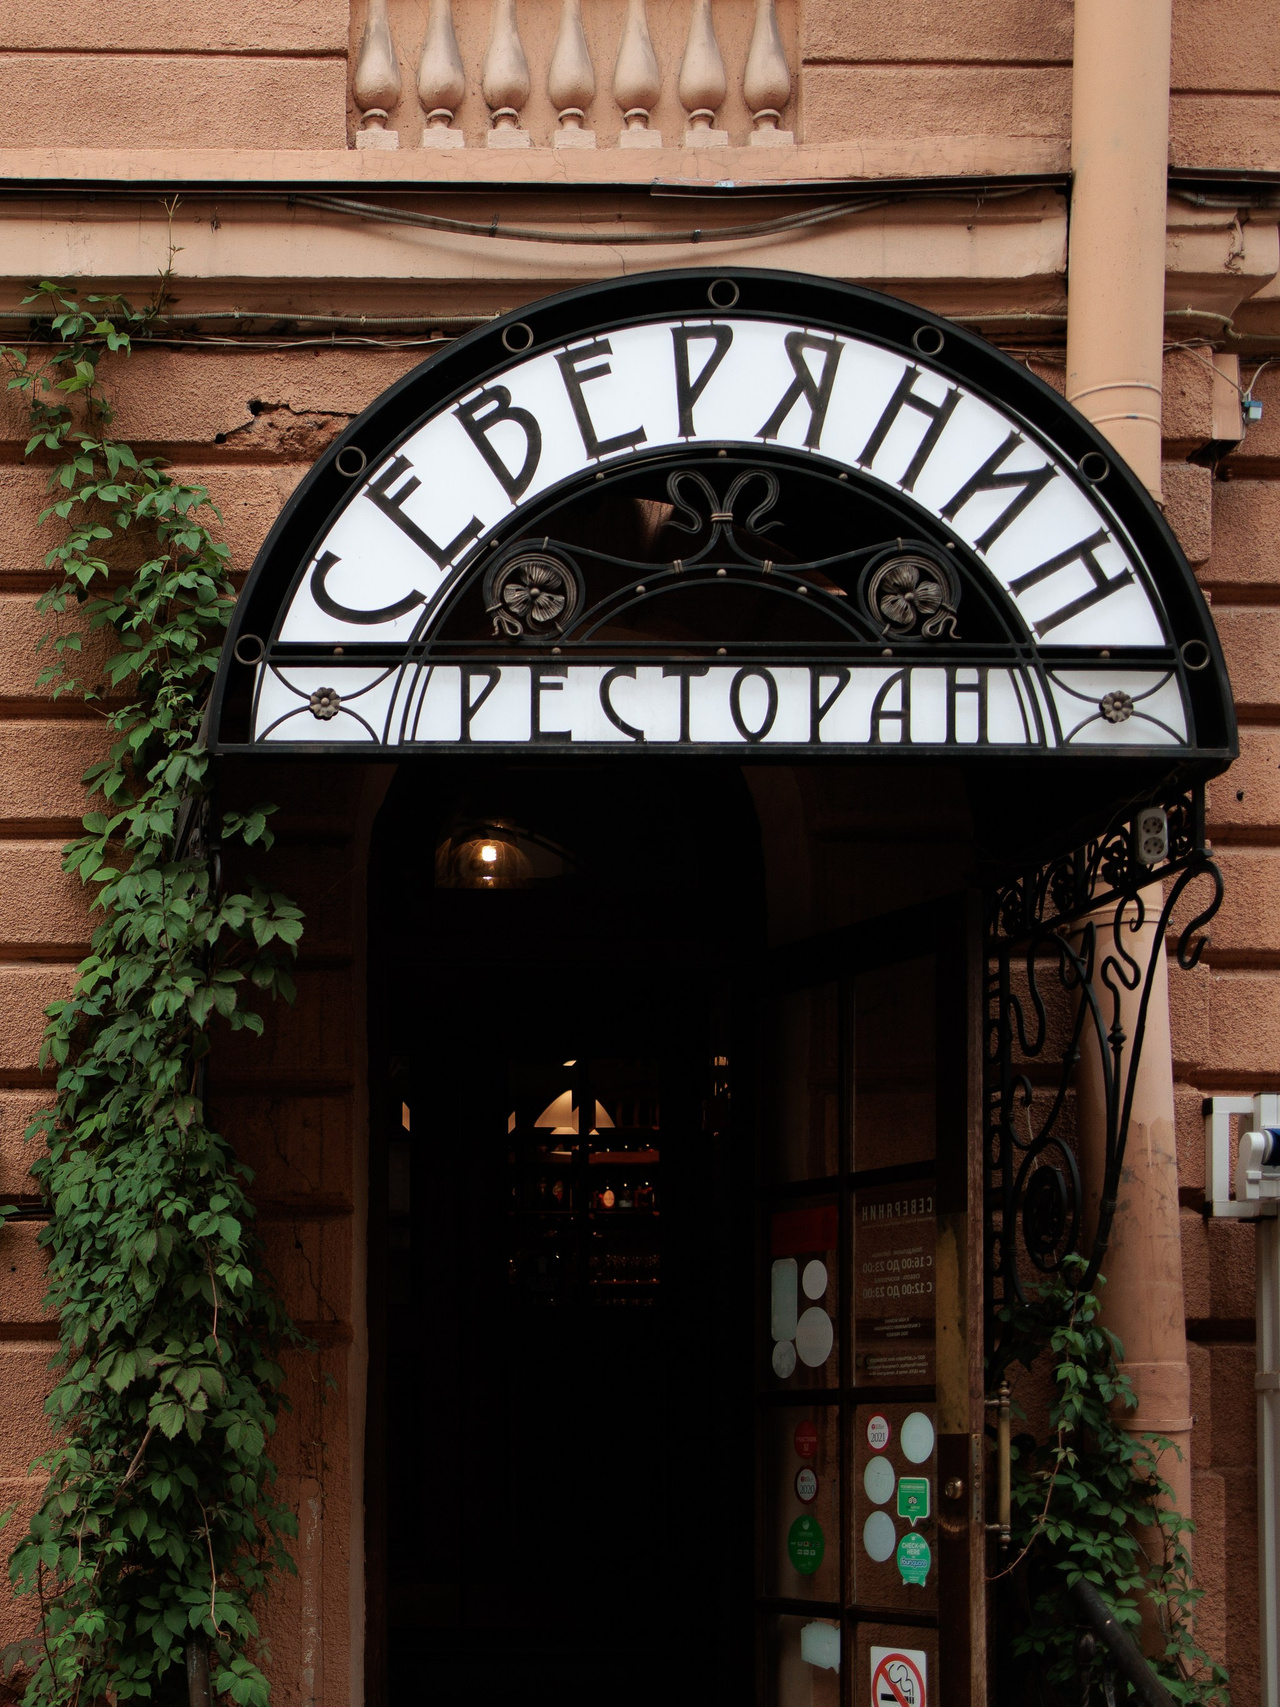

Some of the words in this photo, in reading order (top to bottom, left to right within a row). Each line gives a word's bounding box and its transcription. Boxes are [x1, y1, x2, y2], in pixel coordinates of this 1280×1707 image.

[309, 322, 1136, 643] СЕВЕРЯНИН
[458, 665, 992, 746] РЕСТОРАН
[870, 1432, 885, 1442] 2021
[799, 1484, 816, 1494] 2020
